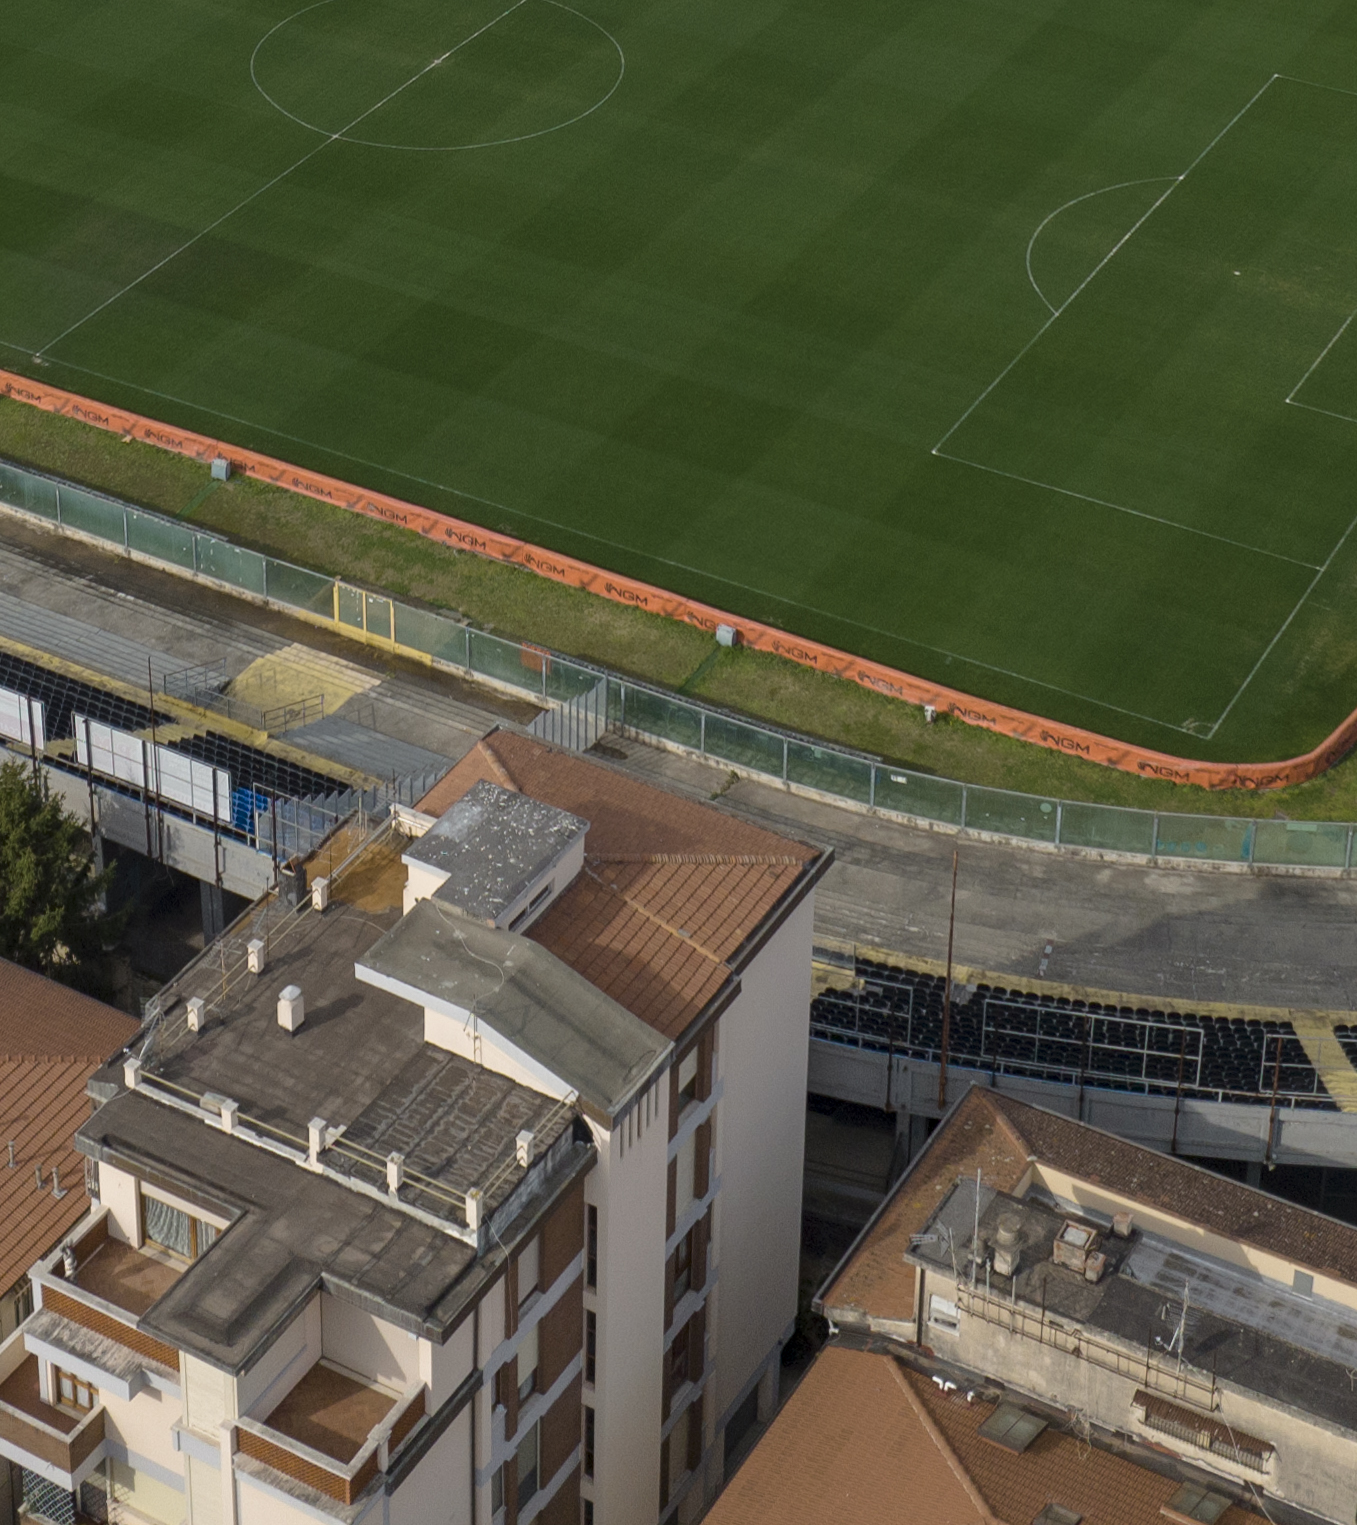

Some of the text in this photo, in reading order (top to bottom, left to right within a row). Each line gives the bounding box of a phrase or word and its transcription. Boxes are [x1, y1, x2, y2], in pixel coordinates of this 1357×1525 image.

[14, 385, 41, 402] NGM
[80, 406, 109, 425] NGM
[153, 430, 183, 448] NGM
[300, 480, 333, 499] NGM
[375, 504, 408, 524] NGM
[452, 530, 486, 550] NGM
[531, 555, 565, 576] NGM
[614, 584, 648, 606] NGM
[782, 642, 818, 665] NGM
[866, 673, 903, 695] NGM
[956, 705, 996, 725] NGM
[1049, 734, 1090, 755] NGM
[1146, 762, 1190, 782] NGM
[1245, 773, 1290, 787] NGM
